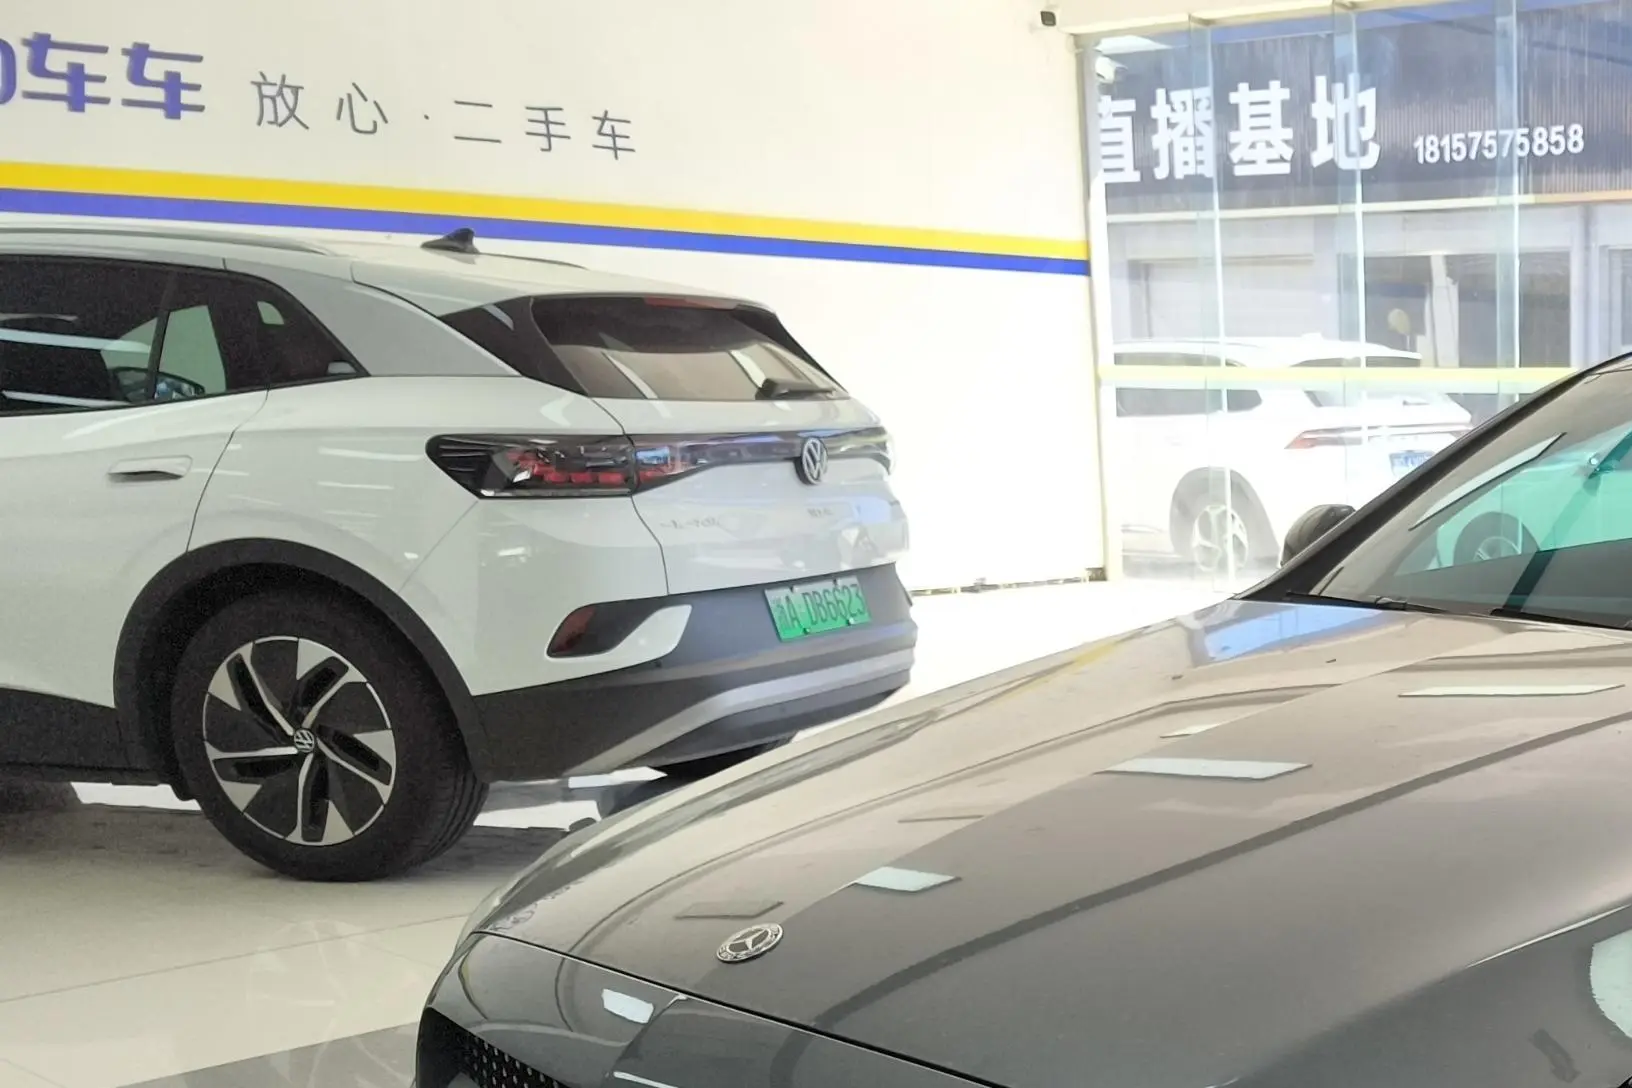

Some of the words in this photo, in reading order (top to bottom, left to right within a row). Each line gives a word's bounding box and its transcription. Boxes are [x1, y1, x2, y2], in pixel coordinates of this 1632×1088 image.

[0, 32, 205, 120] 车车
[1098, 72, 1381, 183] 直播基地
[1413, 123, 1585, 165] 18157575858
